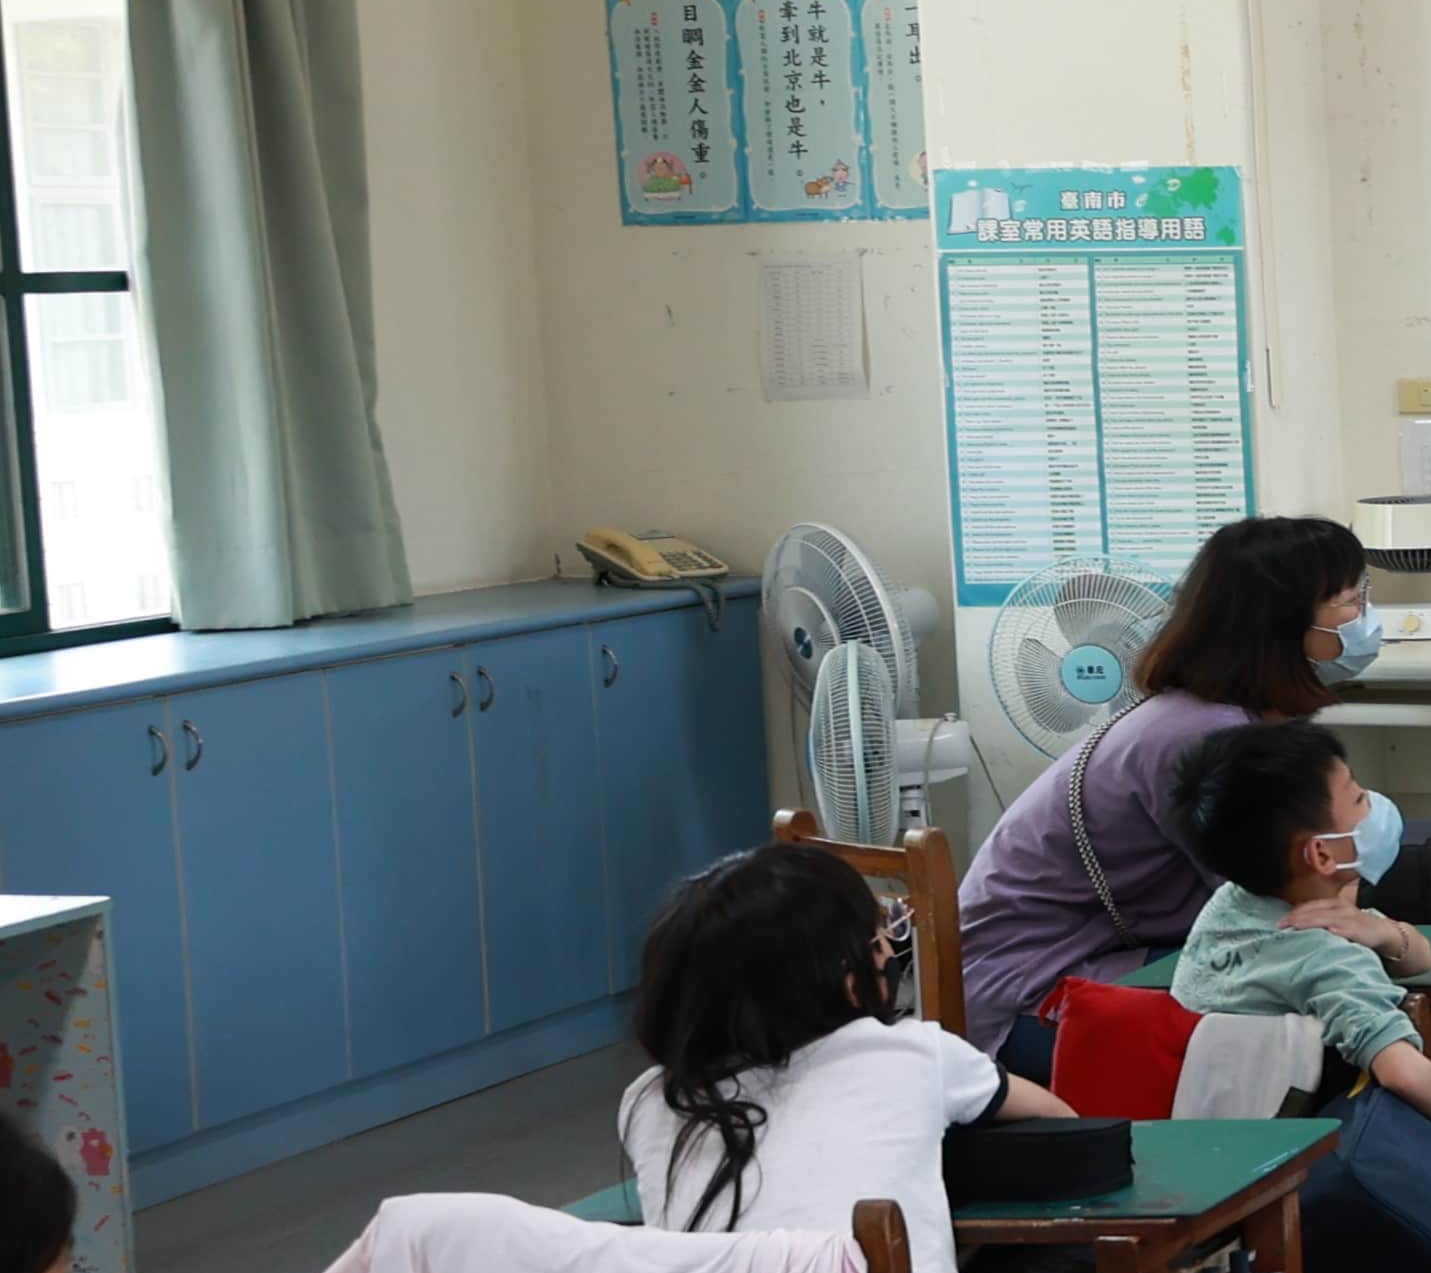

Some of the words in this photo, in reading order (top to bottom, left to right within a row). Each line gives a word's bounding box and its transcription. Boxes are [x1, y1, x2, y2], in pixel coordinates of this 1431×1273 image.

[1059, 189, 1128, 211] 臺南市
[976, 216, 1208, 243] 課室常用英語指導用語
